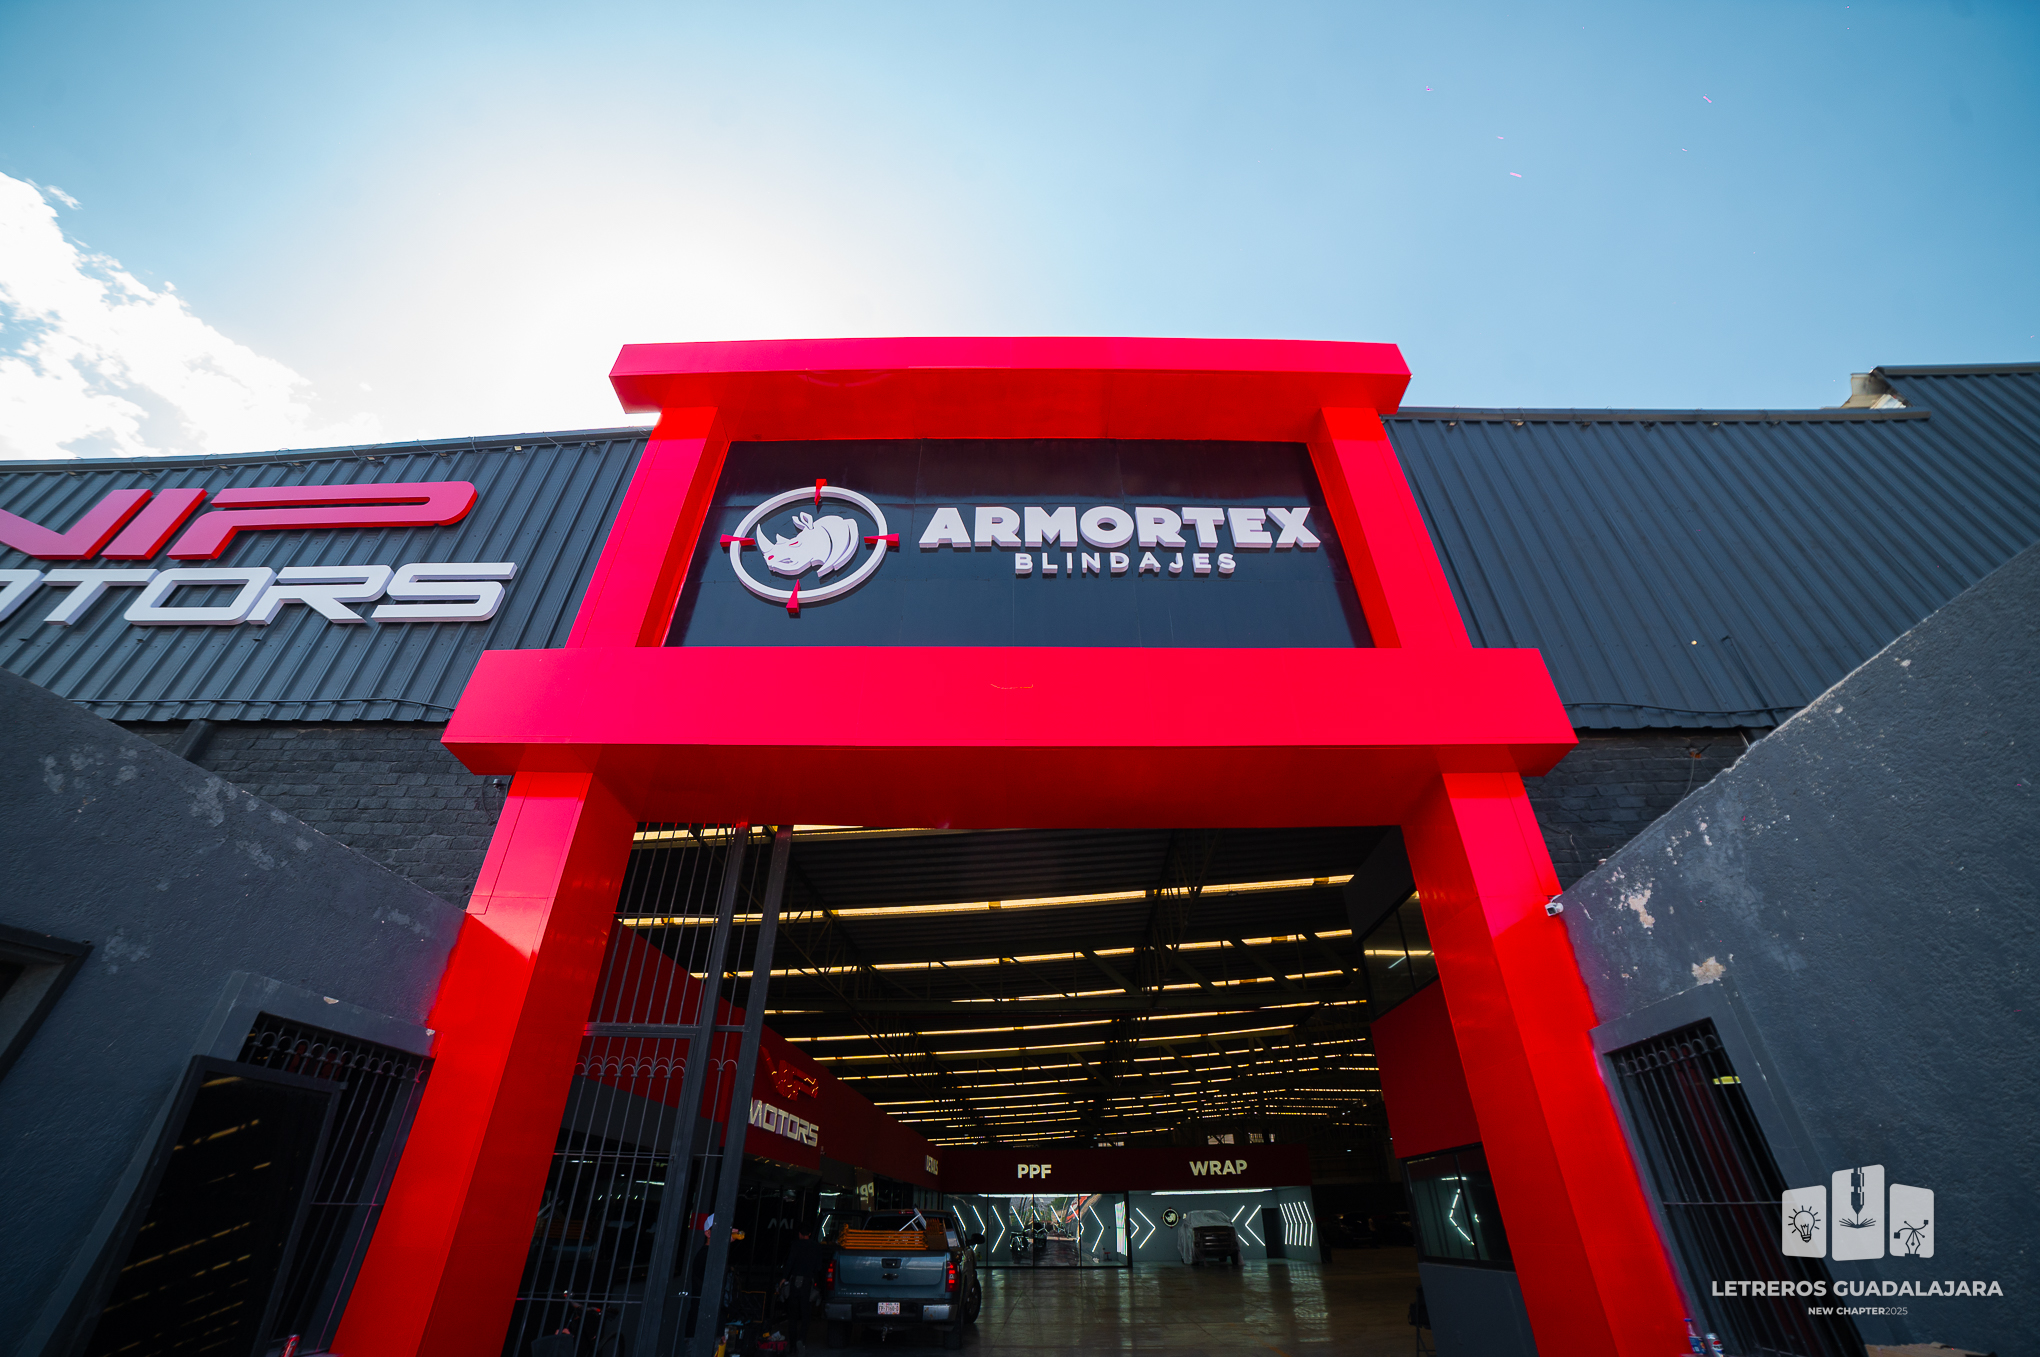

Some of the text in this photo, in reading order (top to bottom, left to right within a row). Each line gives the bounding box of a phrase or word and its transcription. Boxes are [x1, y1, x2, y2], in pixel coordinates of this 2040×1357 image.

[919, 506, 1321, 548] ARMORTEX
[1015, 552, 1236, 574] BLINDAJES
[748, 1097, 819, 1147] MOTORS
[1017, 1163, 1052, 1179] PPF
[1189, 1159, 1248, 1177] WRAP
